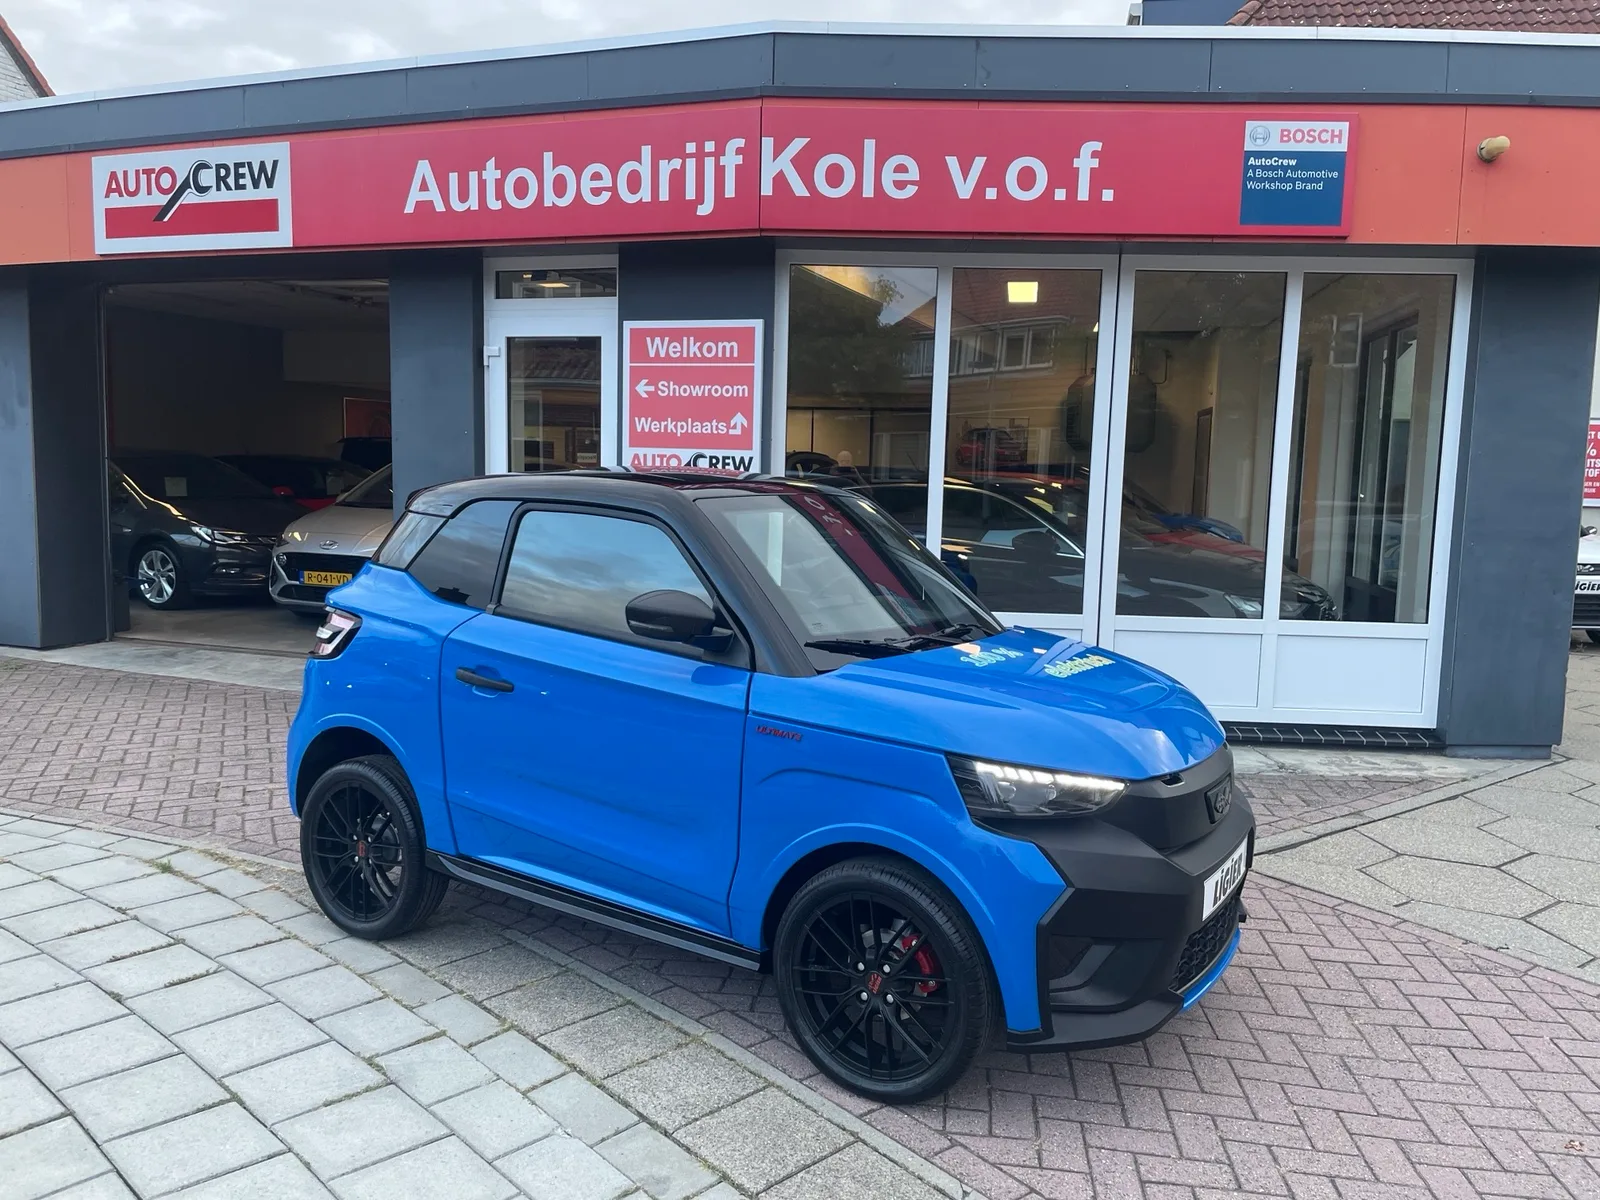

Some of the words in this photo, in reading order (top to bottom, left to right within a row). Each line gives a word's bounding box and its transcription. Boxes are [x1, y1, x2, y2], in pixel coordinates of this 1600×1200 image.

[1279, 128, 1343, 144] BOSCH
[1247, 156, 1297, 166] AutoCrew
[104, 165, 178, 199] AUTO
[188, 158, 279, 195] CREW
[403, 138, 746, 216] Autobedrijf
[760, 136, 920, 200] Kole
[944, 140, 1115, 202] v.o.f.
[1246, 169, 1254, 178] A
[1255, 169, 1284, 178] Bosch
[1285, 169, 1339, 179] Automotive
[1246, 180, 1293, 191] Workshop
[1295, 181, 1324, 191] Brand
[645, 336, 739, 358] Welkom
[657, 380, 749, 398] Showroom
[634, 416, 728, 437] Werkplaats
